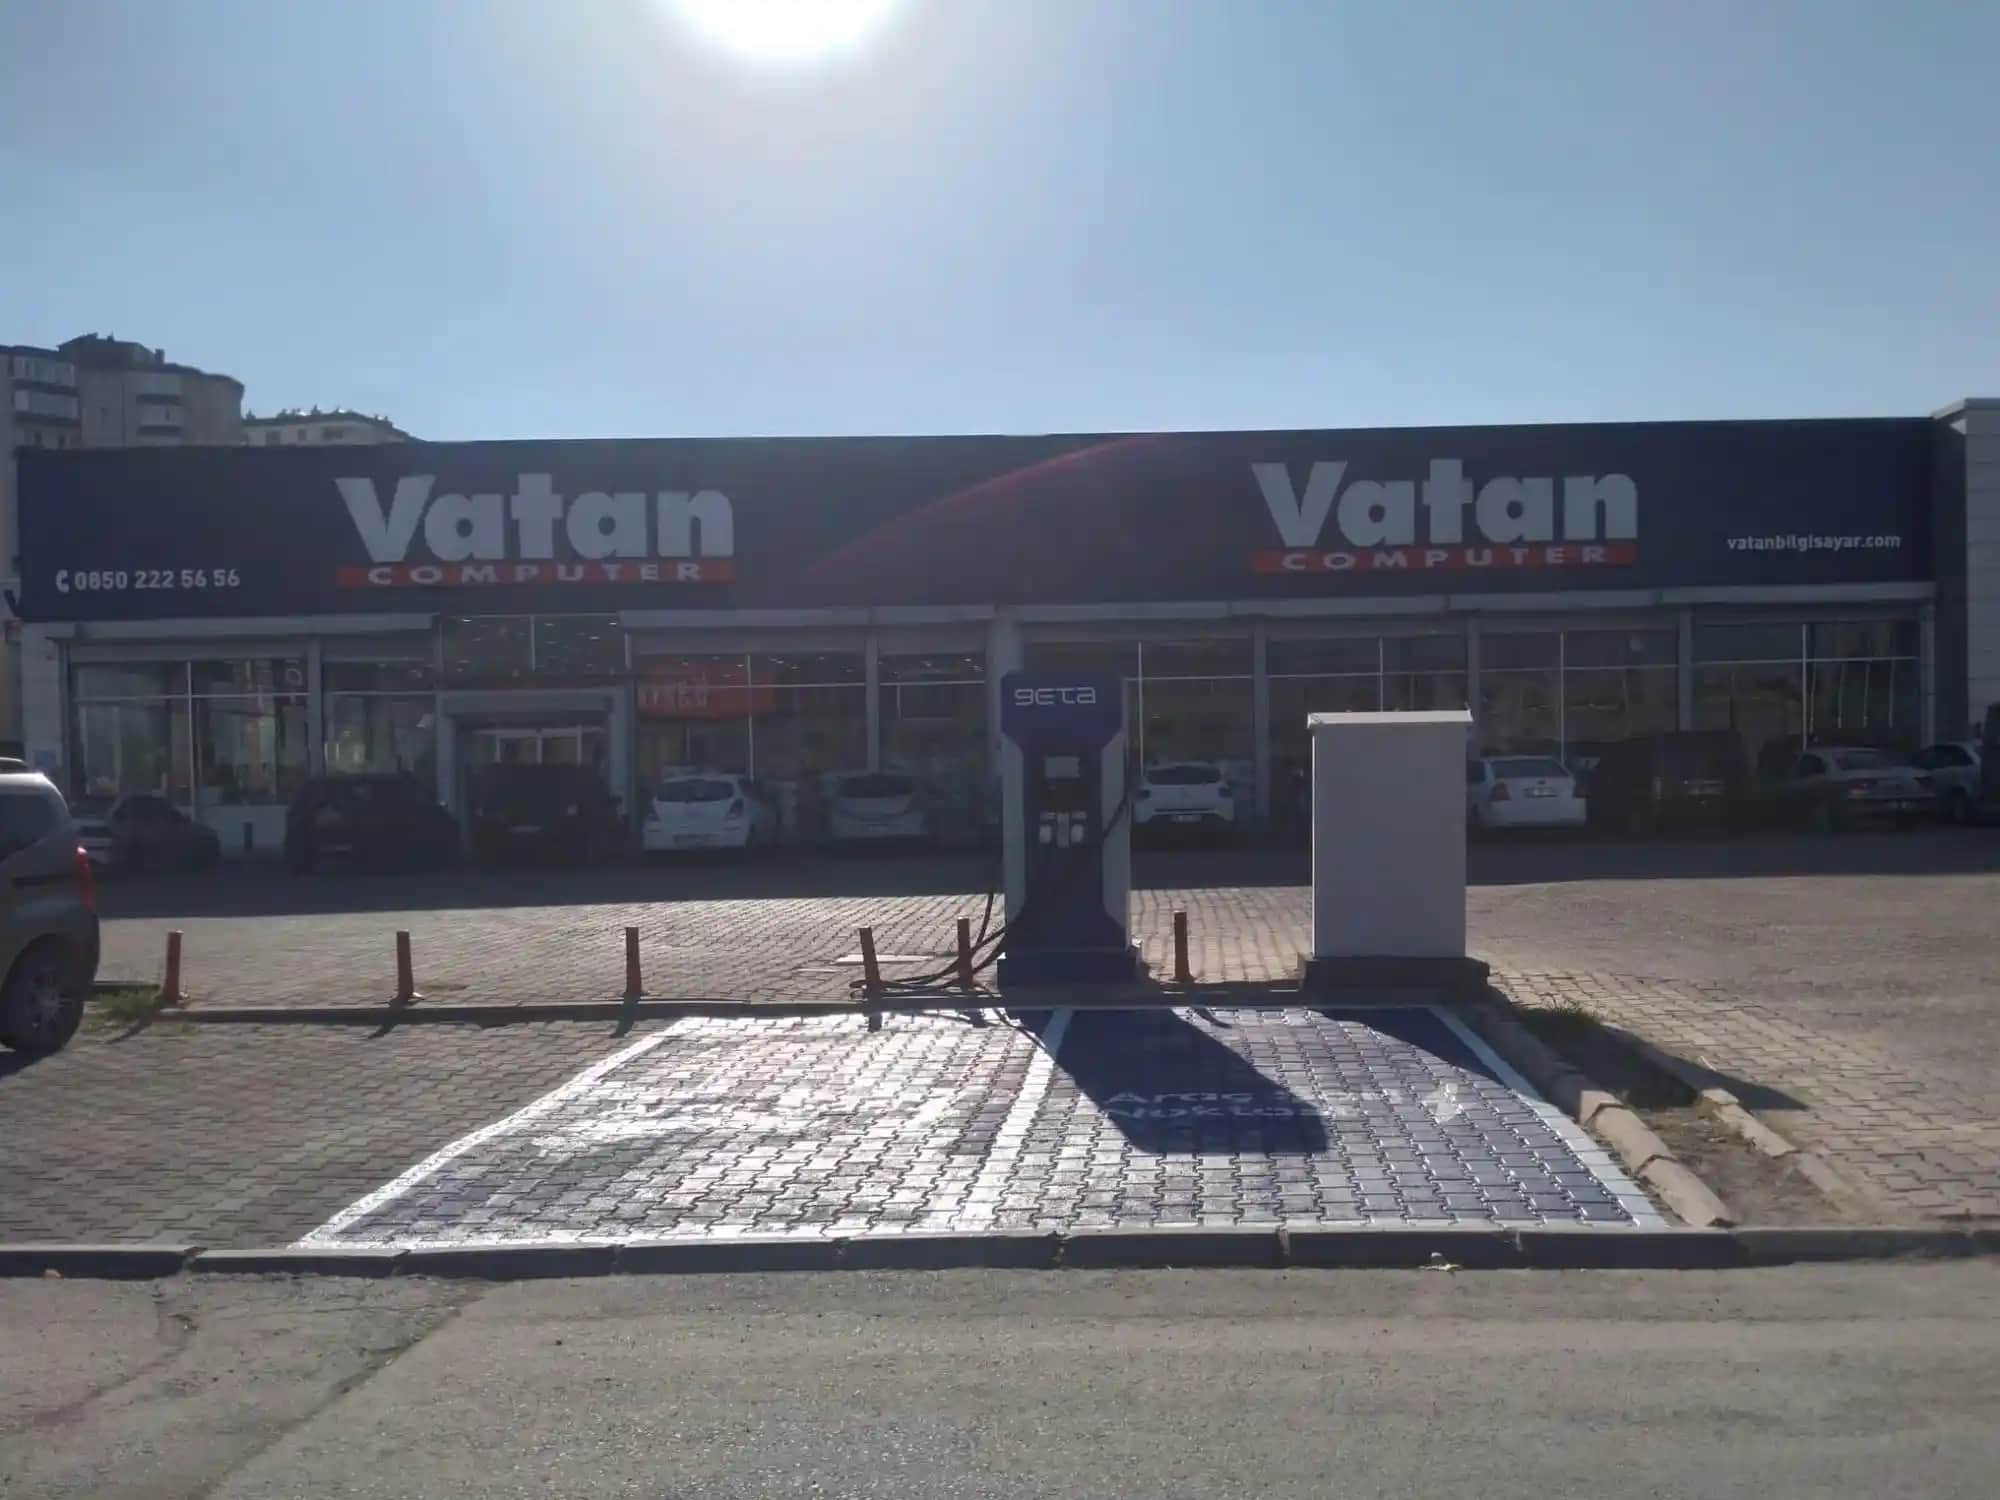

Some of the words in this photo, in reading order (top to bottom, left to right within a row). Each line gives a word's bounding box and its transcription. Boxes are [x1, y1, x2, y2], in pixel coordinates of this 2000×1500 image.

[1251, 459, 1638, 548] Vatan
[334, 473, 734, 563] Vatan
[1727, 535, 1902, 552] vatanbilgisayar.com
[1283, 547, 1606, 571] COMPUTER
[74, 571, 128, 590] 0850
[134, 570, 174, 589] 222
[180, 569, 207, 588] 56
[213, 569, 241, 588] 56
[367, 564, 703, 585] COMPUTER
